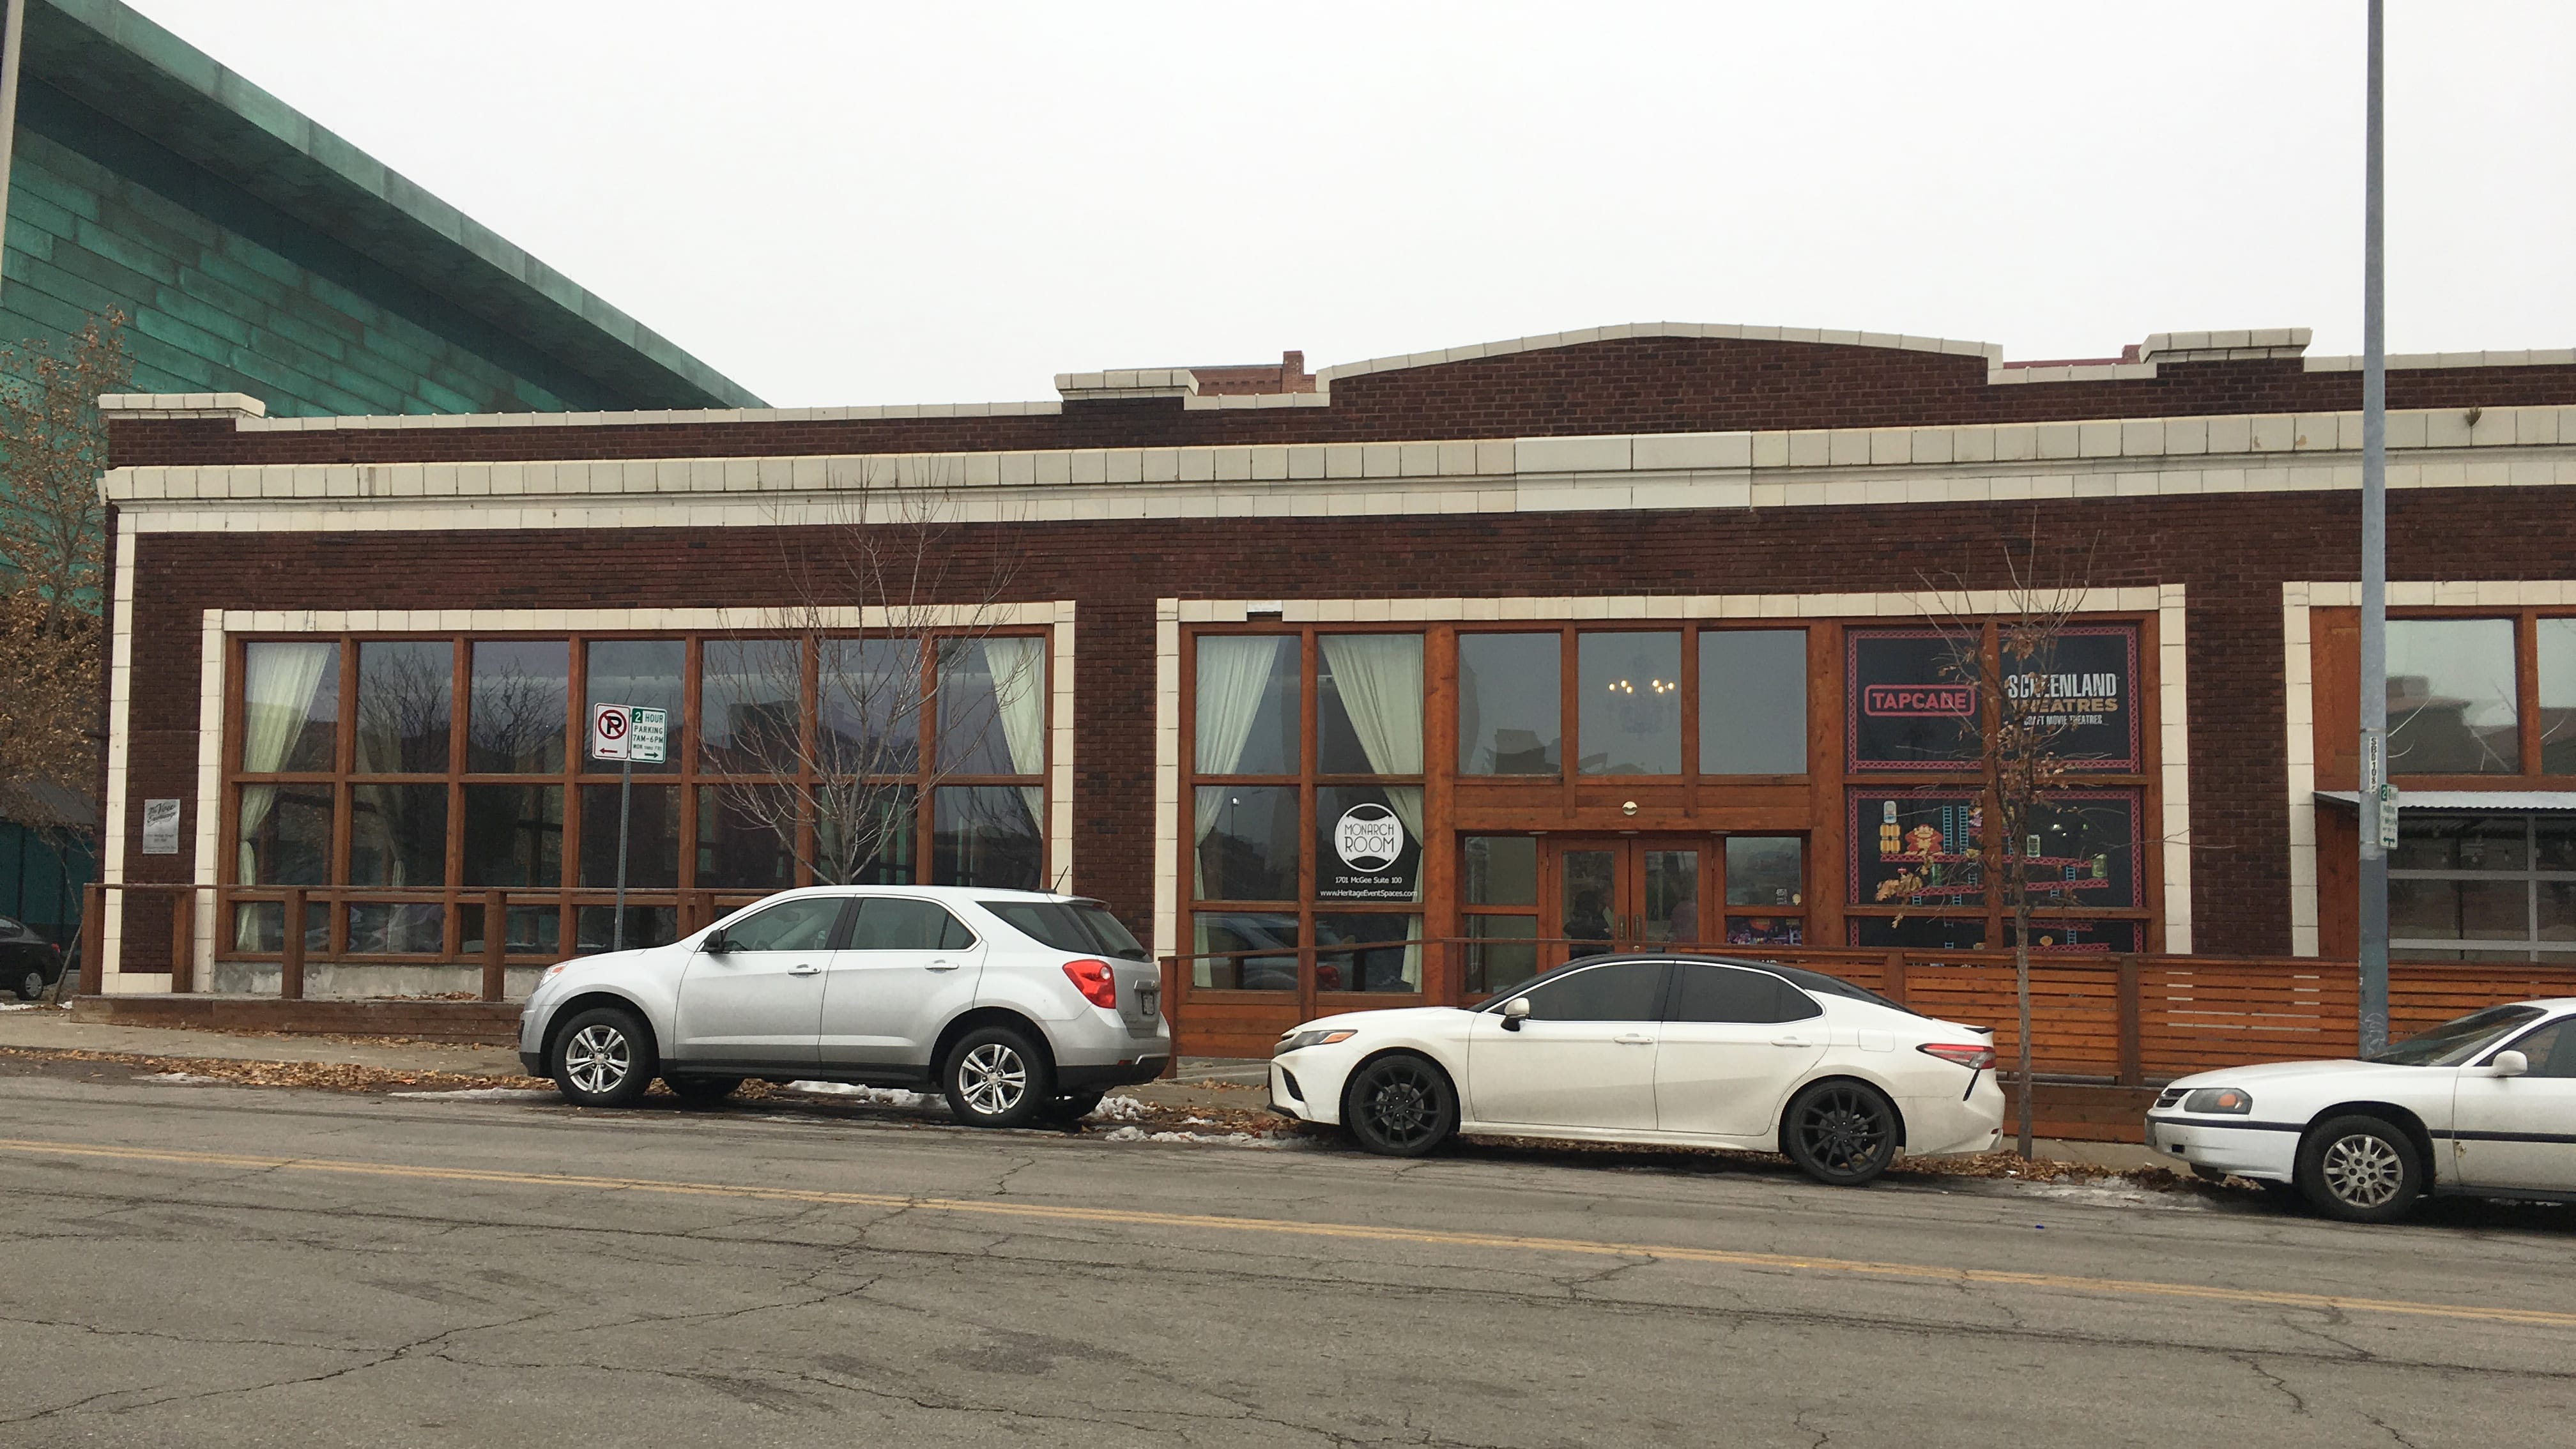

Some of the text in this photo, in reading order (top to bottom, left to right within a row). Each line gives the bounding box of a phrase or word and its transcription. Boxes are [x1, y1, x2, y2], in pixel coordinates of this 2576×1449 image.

[1872, 693, 1967, 709] TAPCADE
[634, 711, 664, 723] 2 HOUR
[2046, 715, 2067, 724] MOVIE
[634, 724, 663, 735] PARKING
[632, 734, 664, 743] 7AM-6PM
[1344, 824, 1394, 836] MONARCH
[1344, 836, 1394, 853] ROOM
[1320, 889, 1418, 898] www.HeritageEventSpaces.com
